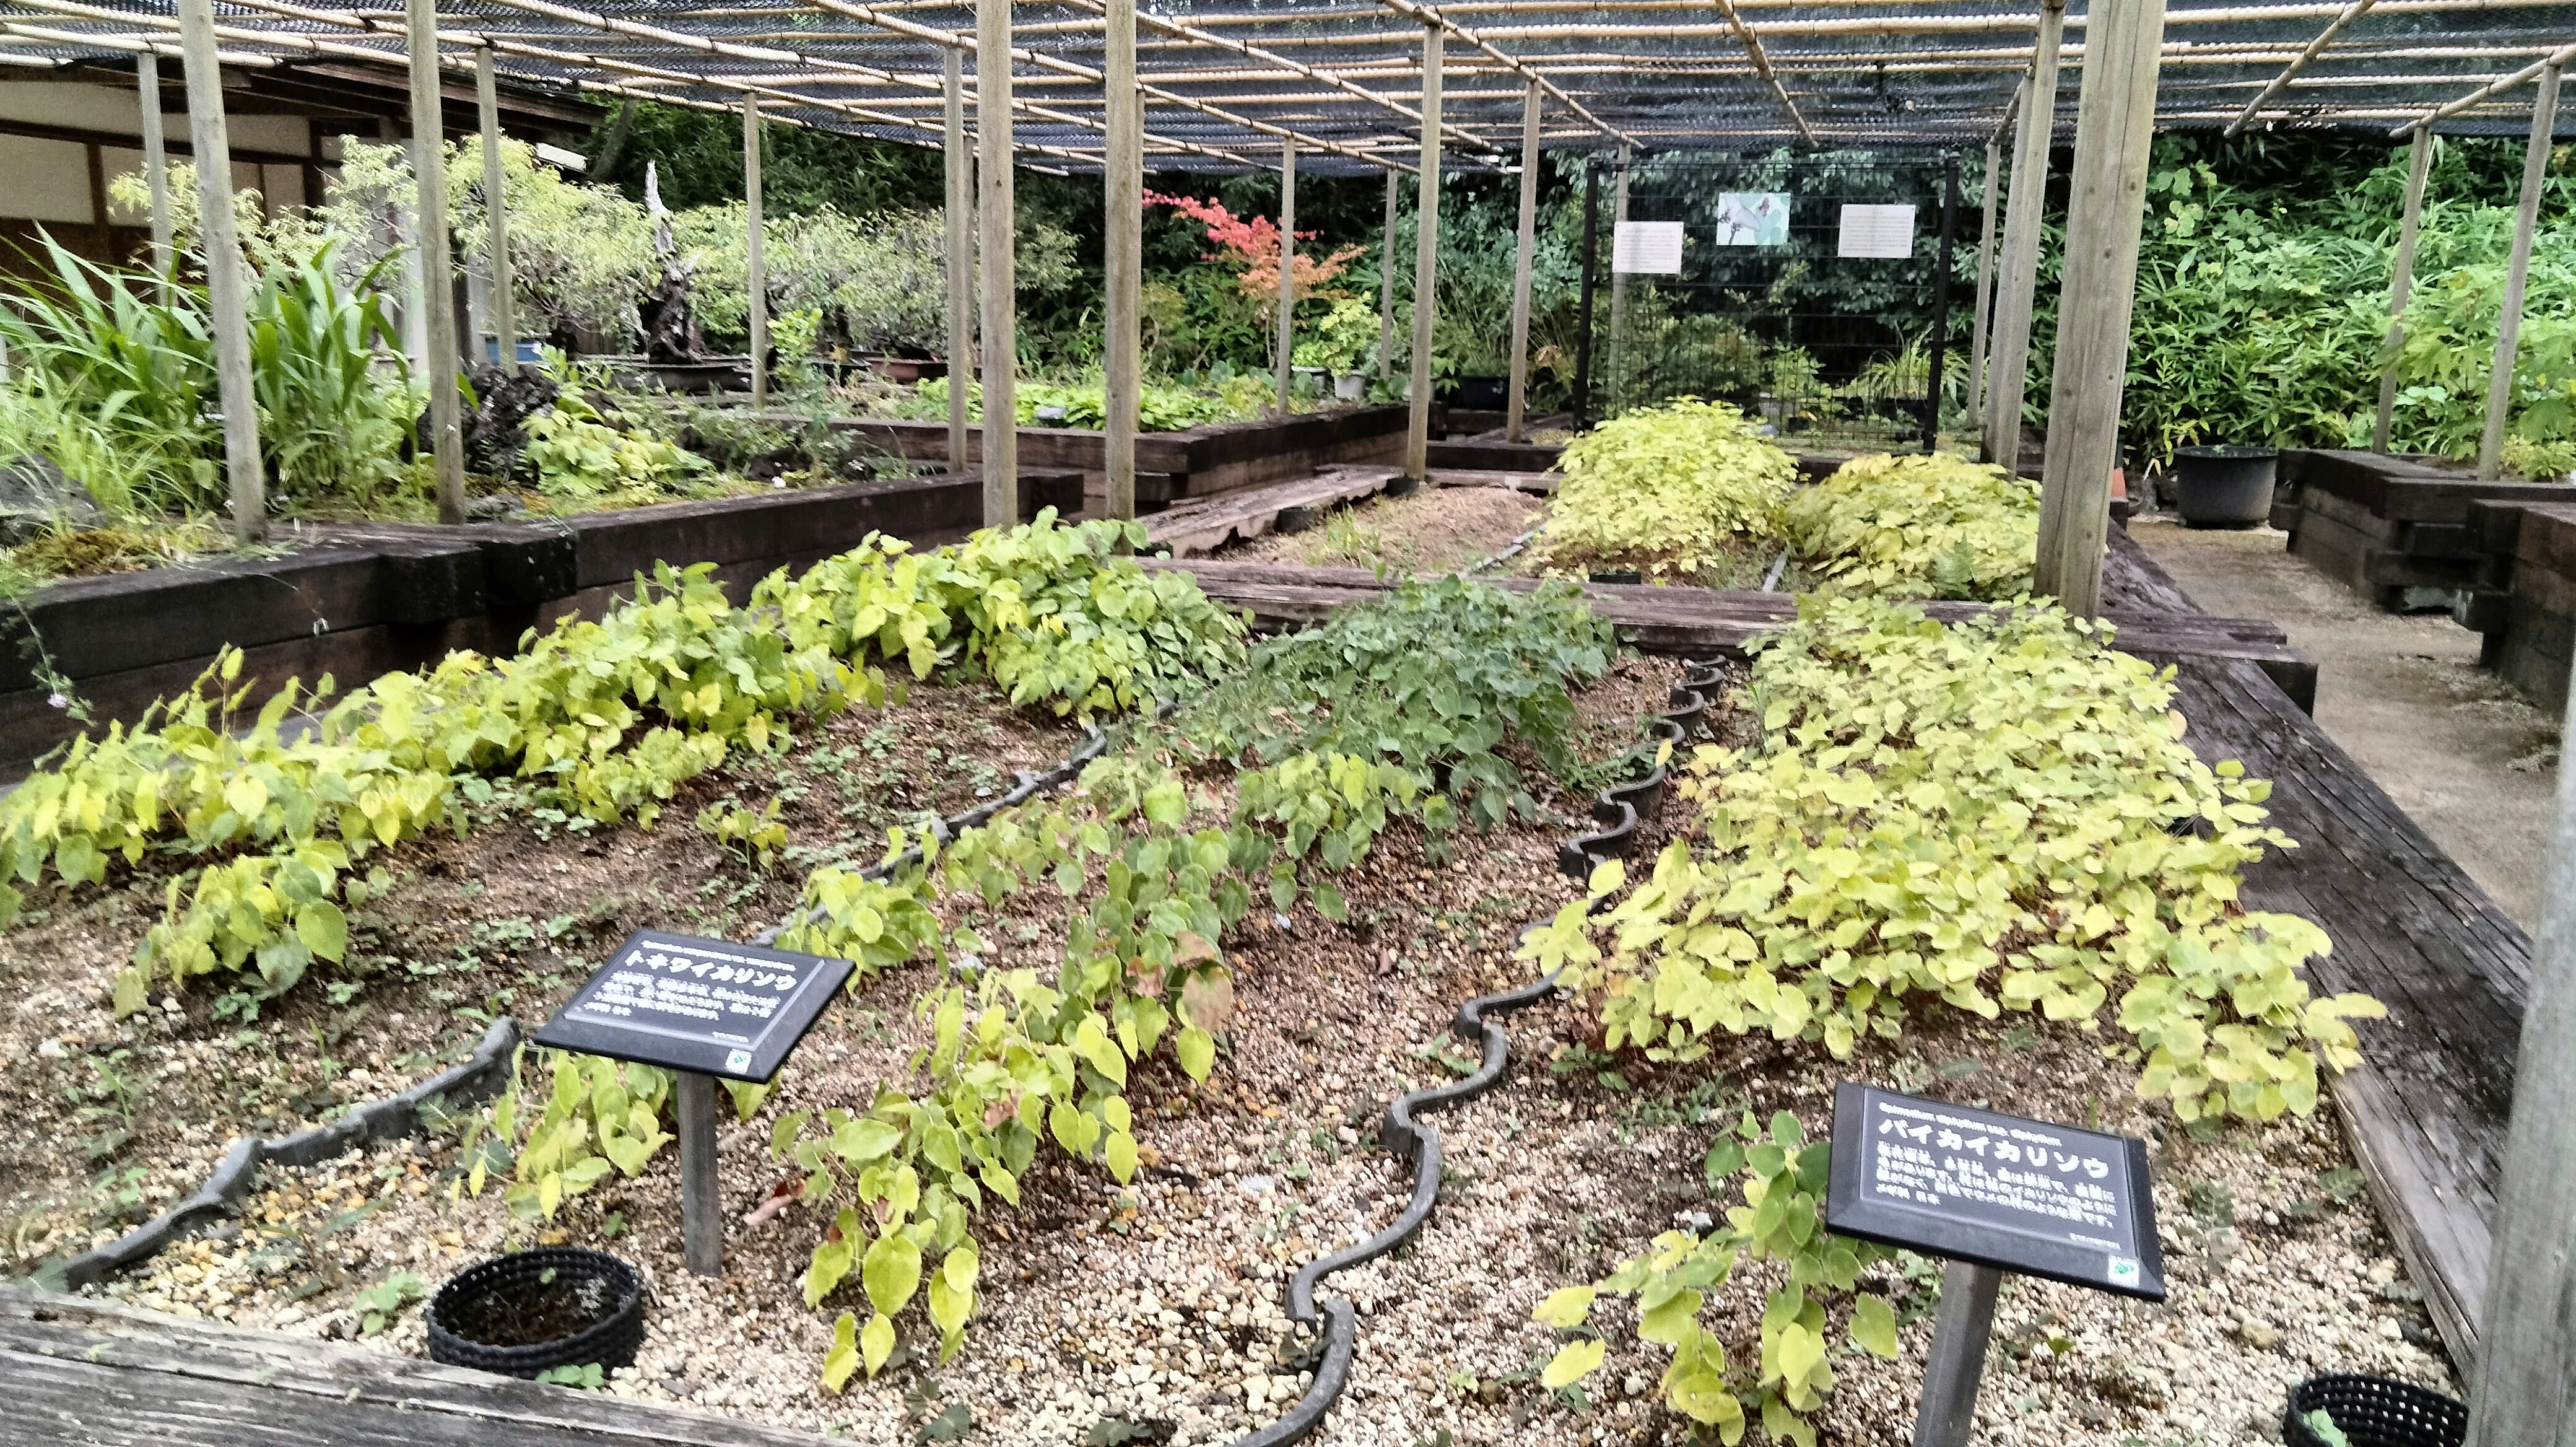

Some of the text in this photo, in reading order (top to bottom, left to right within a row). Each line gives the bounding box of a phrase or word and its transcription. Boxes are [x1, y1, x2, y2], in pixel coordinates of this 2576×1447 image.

[624, 950, 798, 991] トキワイカリソウ
[1878, 1119, 2110, 1179] バイカイカリソウ
